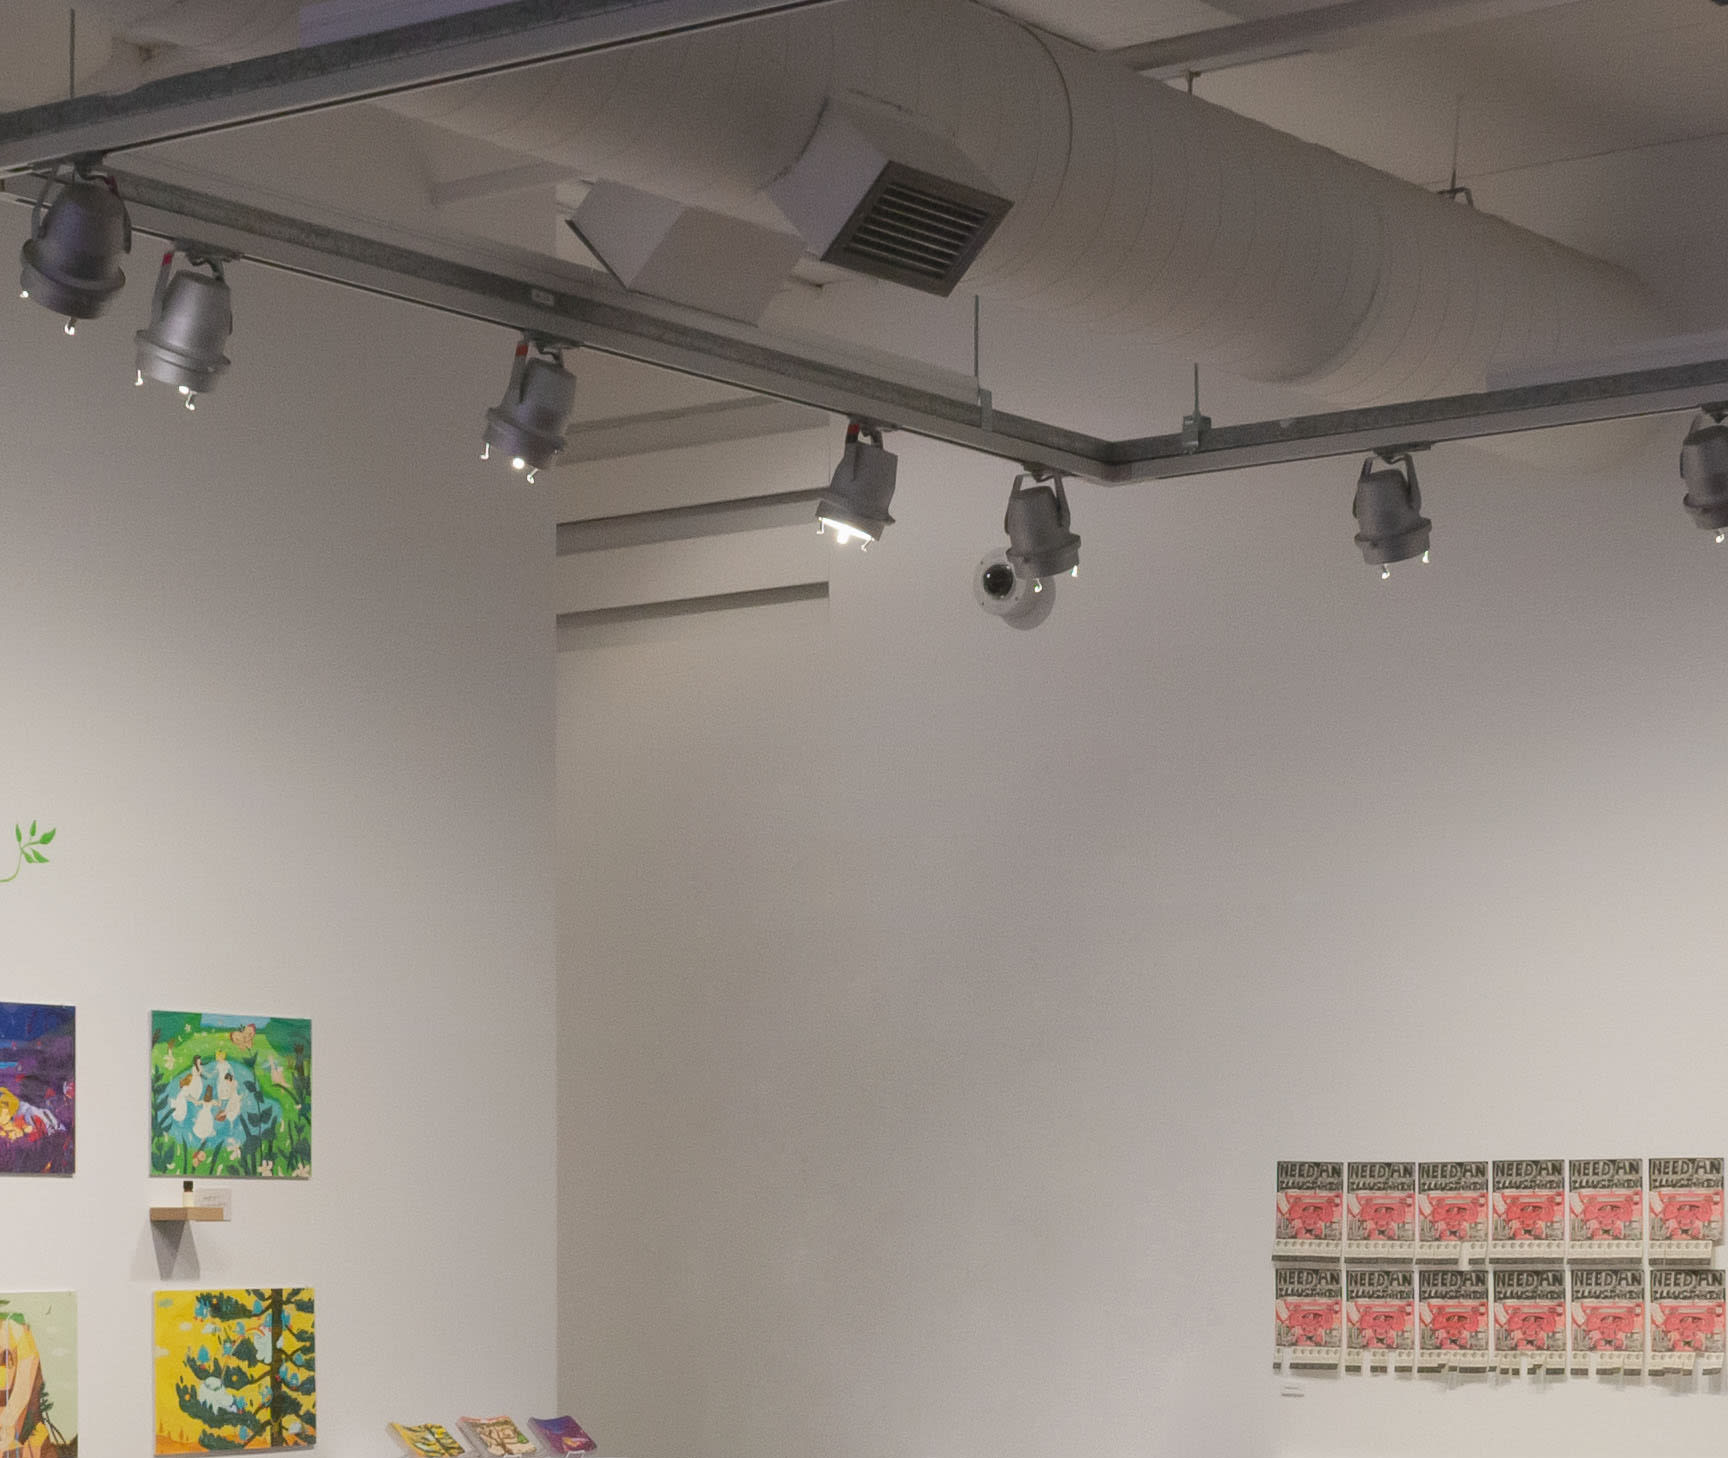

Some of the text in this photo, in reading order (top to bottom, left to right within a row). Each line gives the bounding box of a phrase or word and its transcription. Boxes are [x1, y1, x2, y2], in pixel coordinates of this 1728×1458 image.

[1280, 1162, 1341, 1178] NEED AN
[1349, 1162, 1413, 1178] NEED AN
[1421, 1162, 1485, 1178] NEED AN
[1495, 1161, 1562, 1177] NEED AN
[1571, 1160, 1640, 1177] NEED AN
[1651, 1159, 1721, 1175] NEED AN
[1278, 1270, 1339, 1286] NEED AN
[1348, 1271, 1412, 1286] NEED AN
[1421, 1271, 1486, 1286] NEED AN
[1495, 1271, 1563, 1287] NEED AN
[1574, 1271, 1643, 1287] NEED AN
[1653, 1271, 1724, 1287] NEED AN
